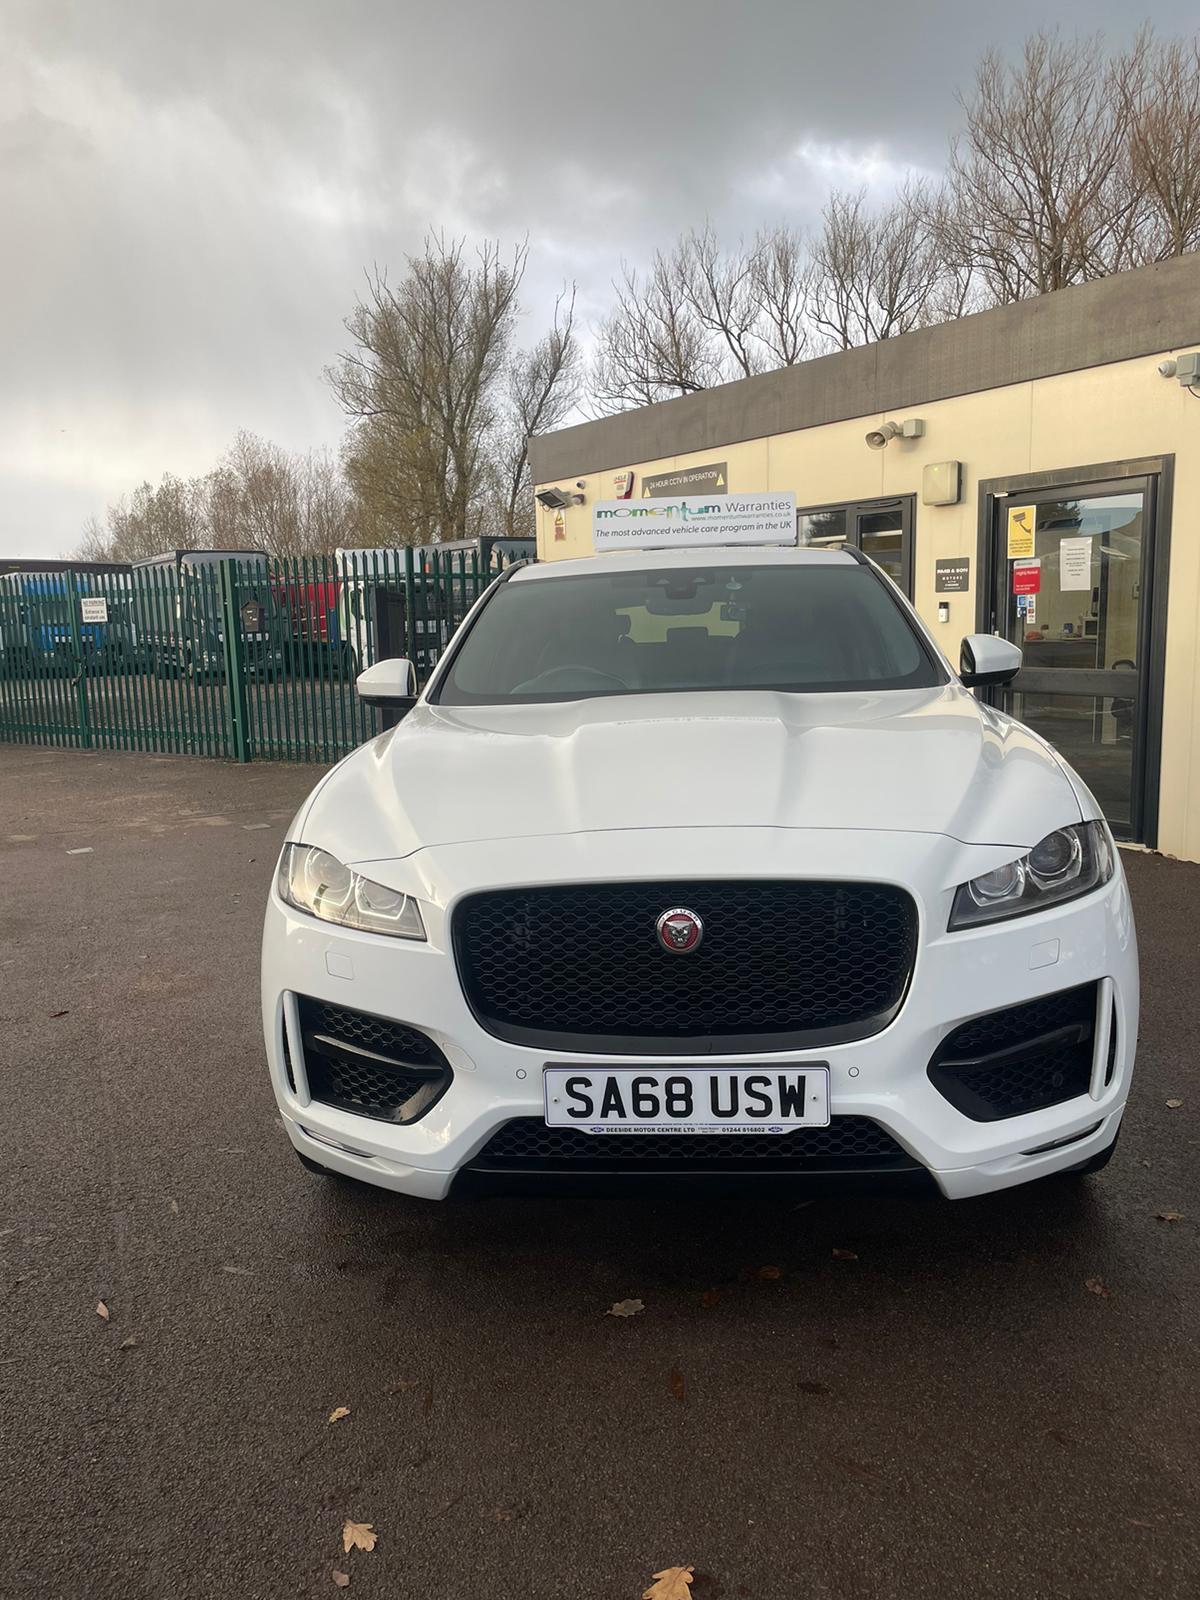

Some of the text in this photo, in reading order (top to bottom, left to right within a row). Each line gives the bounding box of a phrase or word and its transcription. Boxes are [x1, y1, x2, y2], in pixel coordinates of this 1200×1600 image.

[656, 479, 669, 488] HOUR
[669, 477, 682, 486] CCTV
[683, 476, 688, 484] IN
[689, 471, 718, 483] OPERATION
[597, 500, 791, 521] momentum Warranties
[596, 521, 792, 537] The most advanced vehicle care program in the UK
[565, 1075, 806, 1118] SA68 USW
